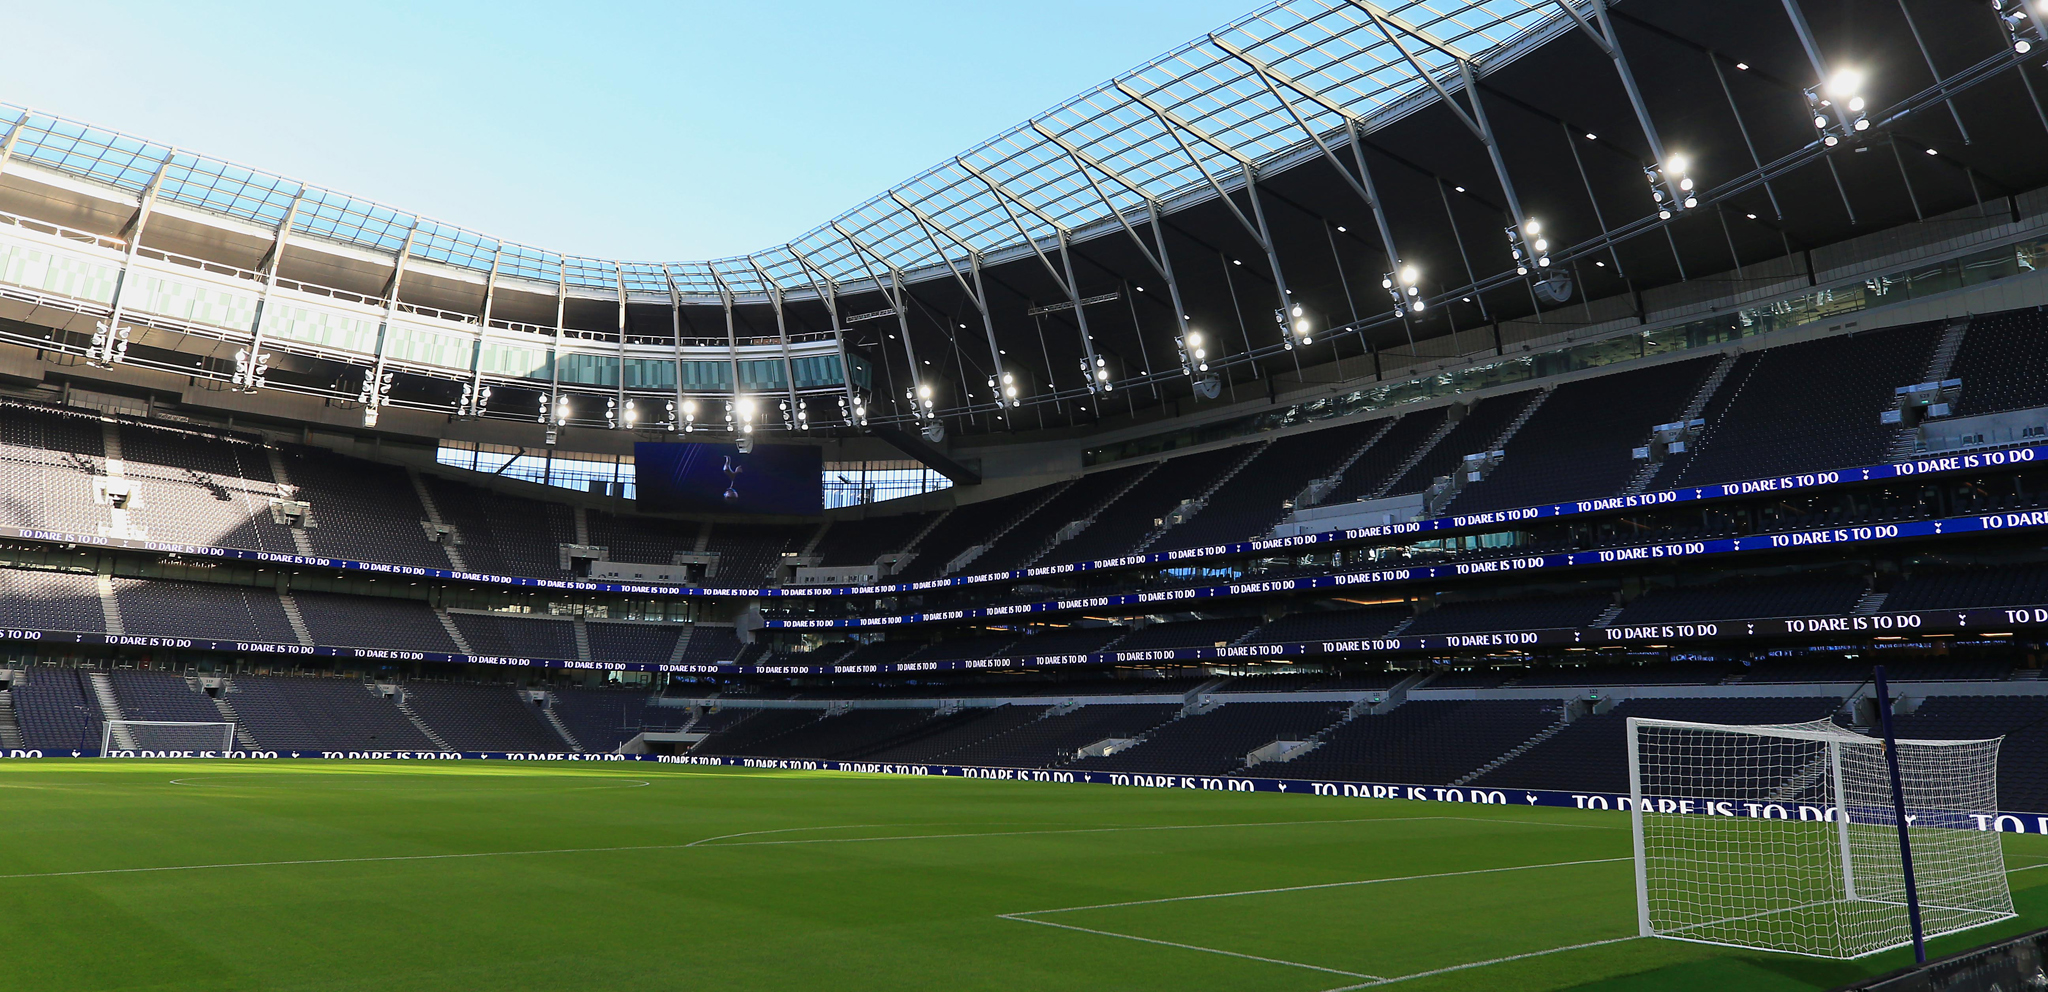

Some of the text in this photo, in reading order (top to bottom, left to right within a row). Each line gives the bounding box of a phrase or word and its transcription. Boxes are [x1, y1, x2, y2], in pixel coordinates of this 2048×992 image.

[1894, 449, 2034, 475] TO DARE IS TO DO
[1722, 472, 1838, 495] TO DARE IS TO DO
[1577, 491, 1676, 512] TO DARE IS TO DO
[1453, 508, 1538, 526] TO DARE IS TO DO
[19, 529, 32, 538] TO
[34, 530, 62, 541] DARE
[77, 534, 90, 543] TO
[93, 536, 107, 545] DO
[1346, 522, 1420, 539] TO DARE IS TO DO
[1771, 525, 1898, 546] TO DARE IS TO DO
[144, 541, 156, 549] TO
[158, 543, 183, 552] DARE
[197, 546, 208, 554] TO
[1252, 535, 1316, 550] TO DARE IS TO DO
[270, 554, 293, 562] DARE
[1178, 549, 1196, 558] DARE
[1198, 548, 1204, 556] IS
[1205, 547, 1214, 555] TO
[1216, 546, 1226, 554] DO
[1599, 543, 1704, 561] TO DARE IS TO DO
[371, 564, 391, 572] DARE
[1456, 557, 1544, 574] TO DARE IS TO DO
[1335, 570, 1409, 584] TO DARE IS TO DO
[1230, 580, 1294, 594] TO DARE IS TO DO
[1785, 615, 1920, 632] TO DARE IS TO DO
[1606, 624, 1717, 639] TO DARE IS TO DO
[120, 636, 147, 645] DARE
[1323, 639, 1400, 652] TO DARE IS TO DO
[1446, 633, 1537, 646] TO DARE IS TO DO
[251, 644, 275, 652] DARE
